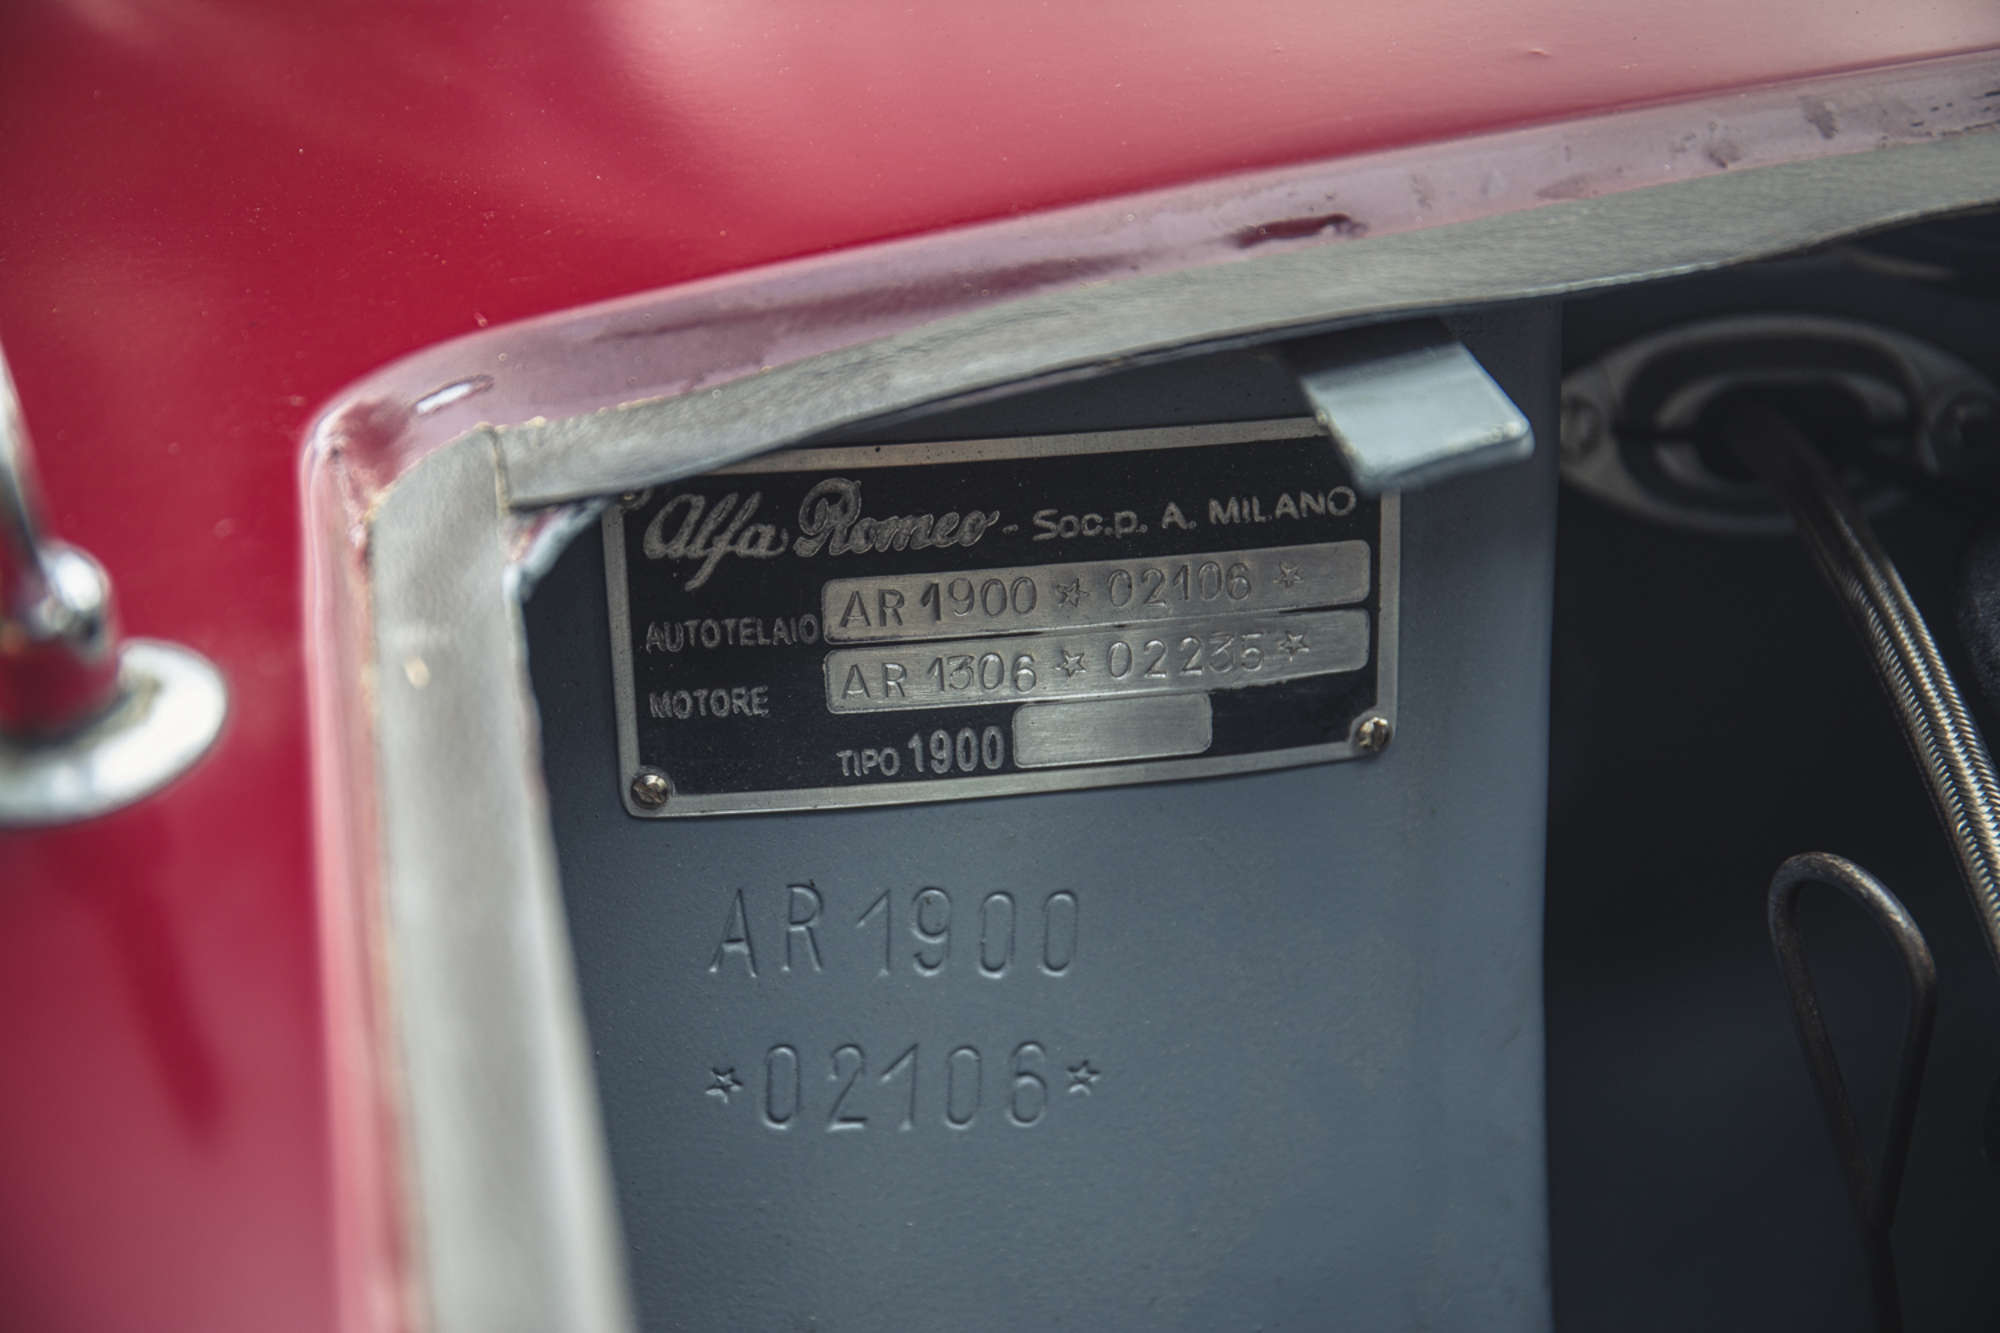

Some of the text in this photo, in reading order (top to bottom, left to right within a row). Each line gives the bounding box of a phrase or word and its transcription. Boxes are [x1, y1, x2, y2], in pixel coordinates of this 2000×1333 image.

[642, 491, 789, 592] Alfa
[793, 476, 1000, 558] Romeo
[1208, 486, 1357, 526] MILANO
[1107, 560, 1252, 608] 02106
[645, 614, 818, 654] AUTOTELAIO
[648, 686, 770, 719] MOTORE
[836, 725, 1005, 777] TIPO 1900
